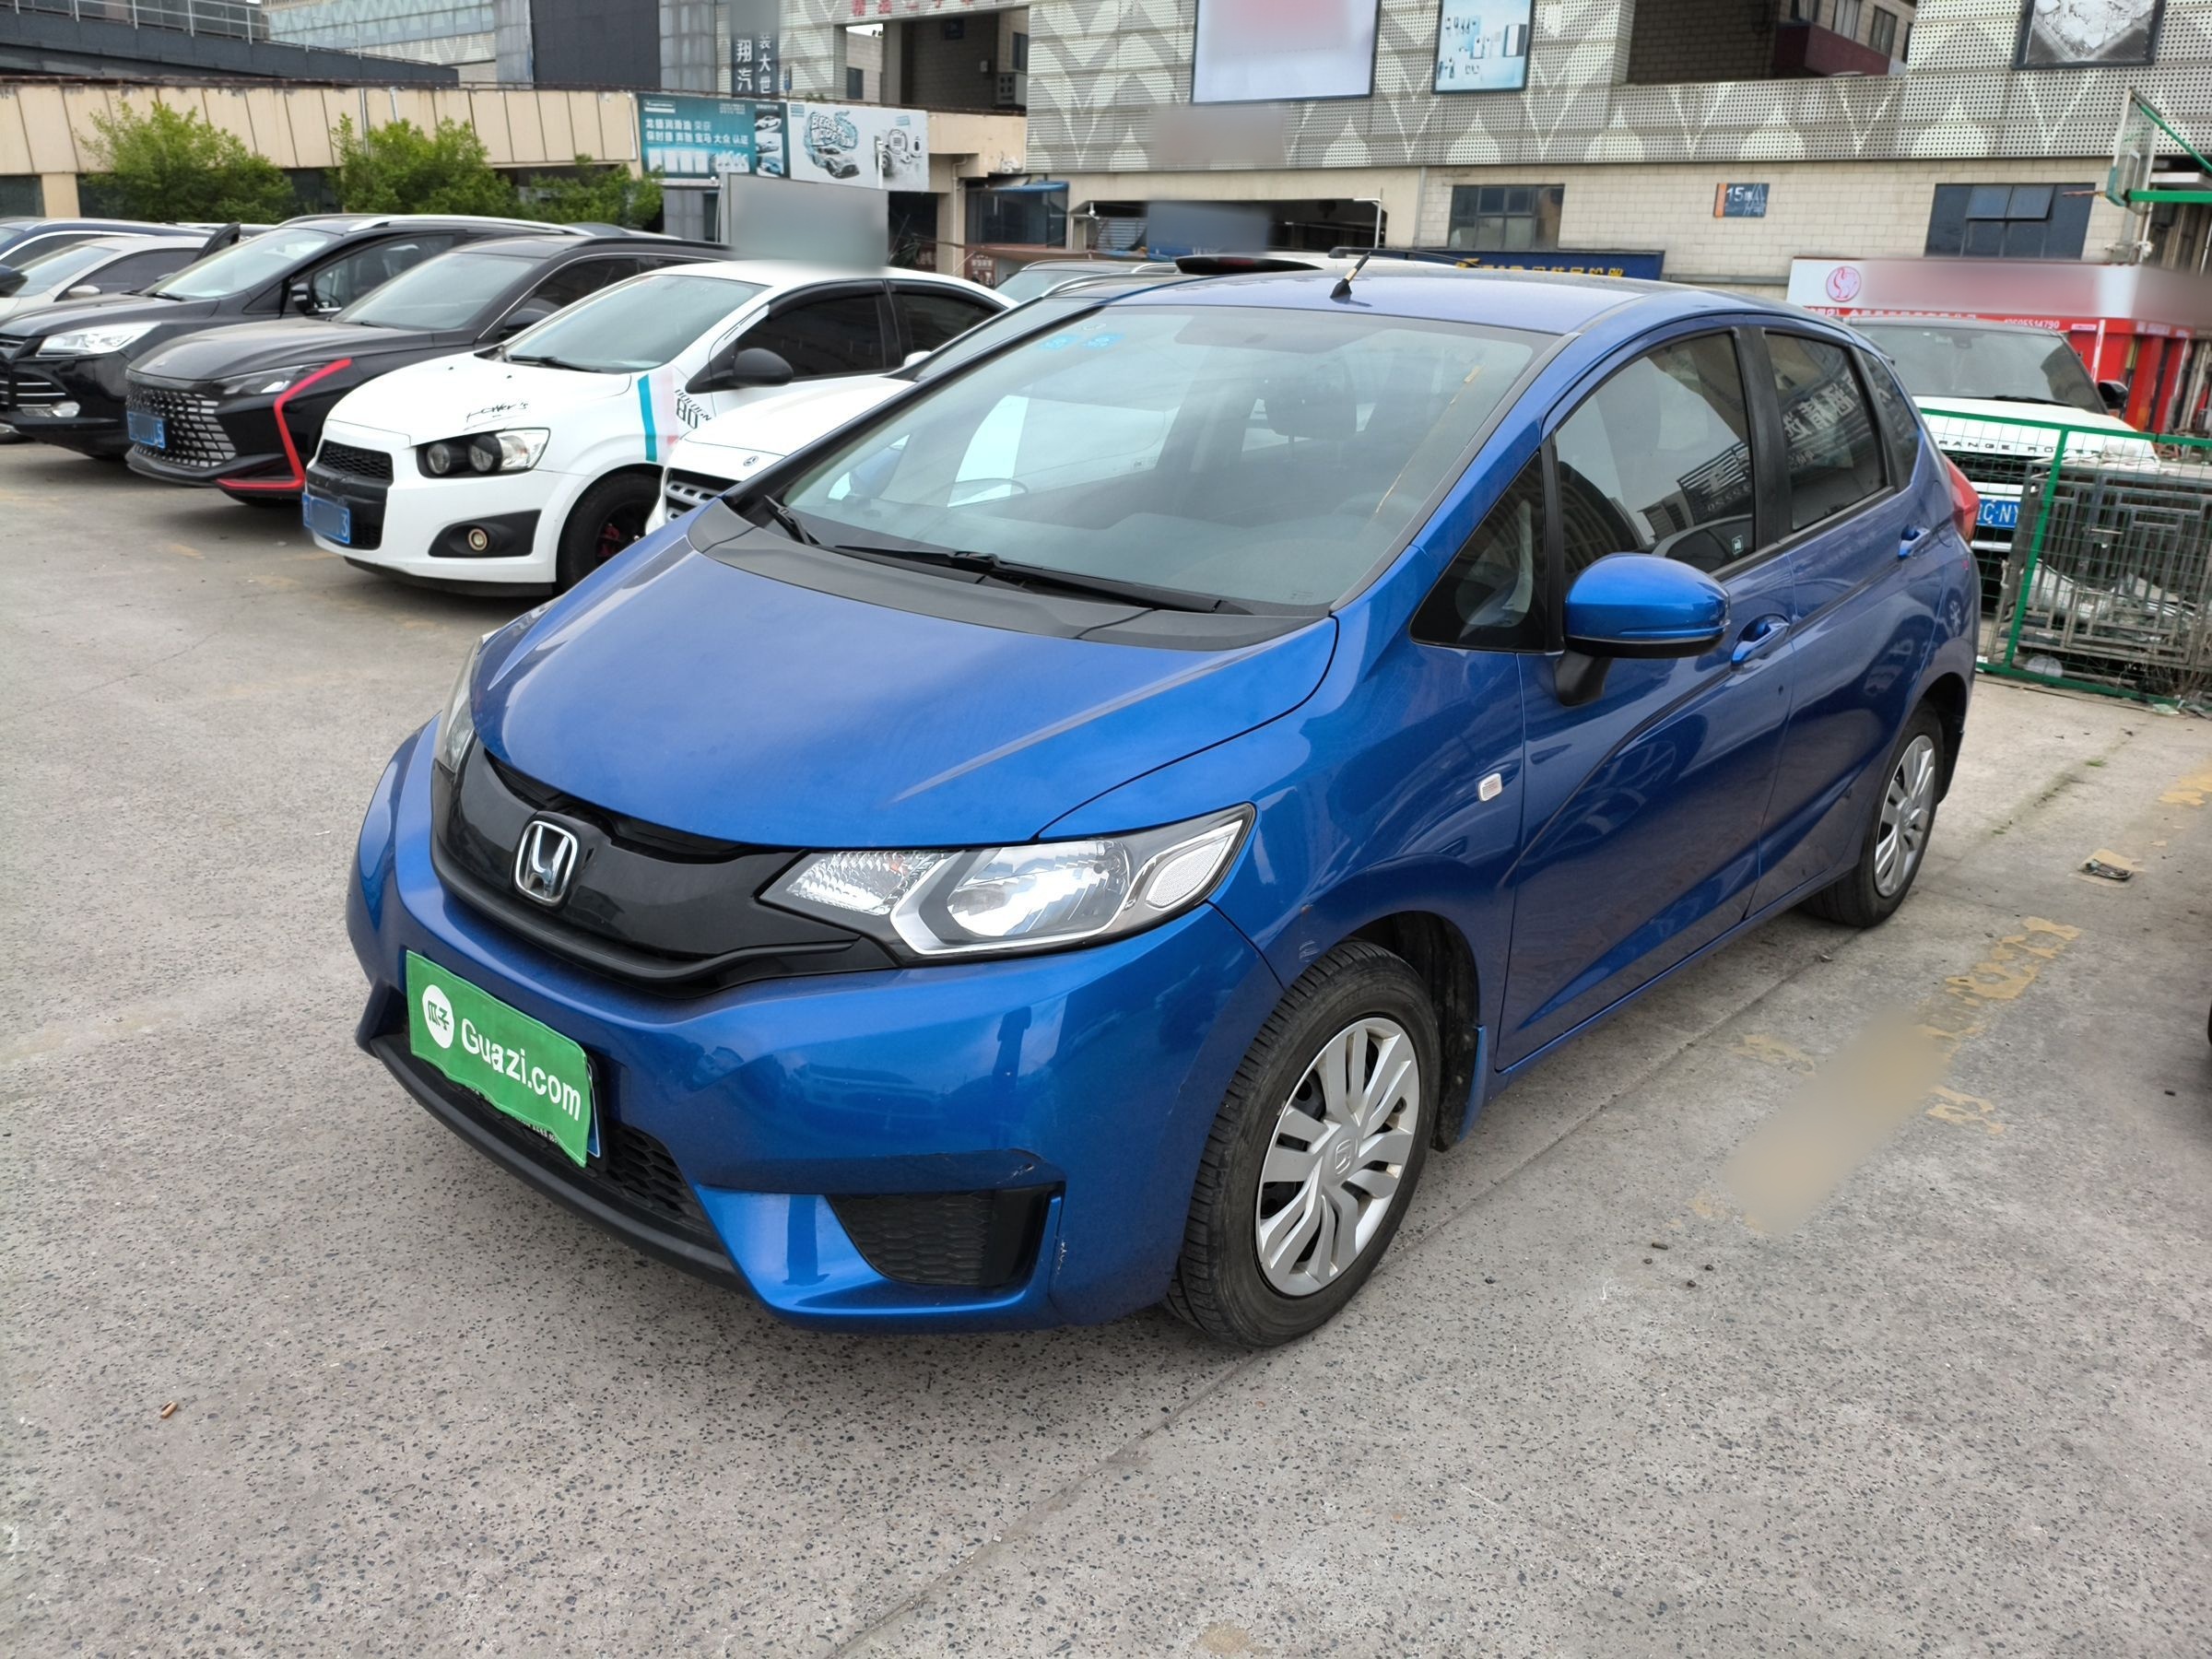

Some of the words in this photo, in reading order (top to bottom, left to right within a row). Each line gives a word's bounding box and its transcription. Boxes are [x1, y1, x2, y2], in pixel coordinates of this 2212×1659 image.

[1938, 440, 2010, 451] RANGE
[2028, 446, 2100, 455] ROER
[427, 999, 450, 1031] 瓜子
[462, 1018, 582, 1122] Guazi.com
